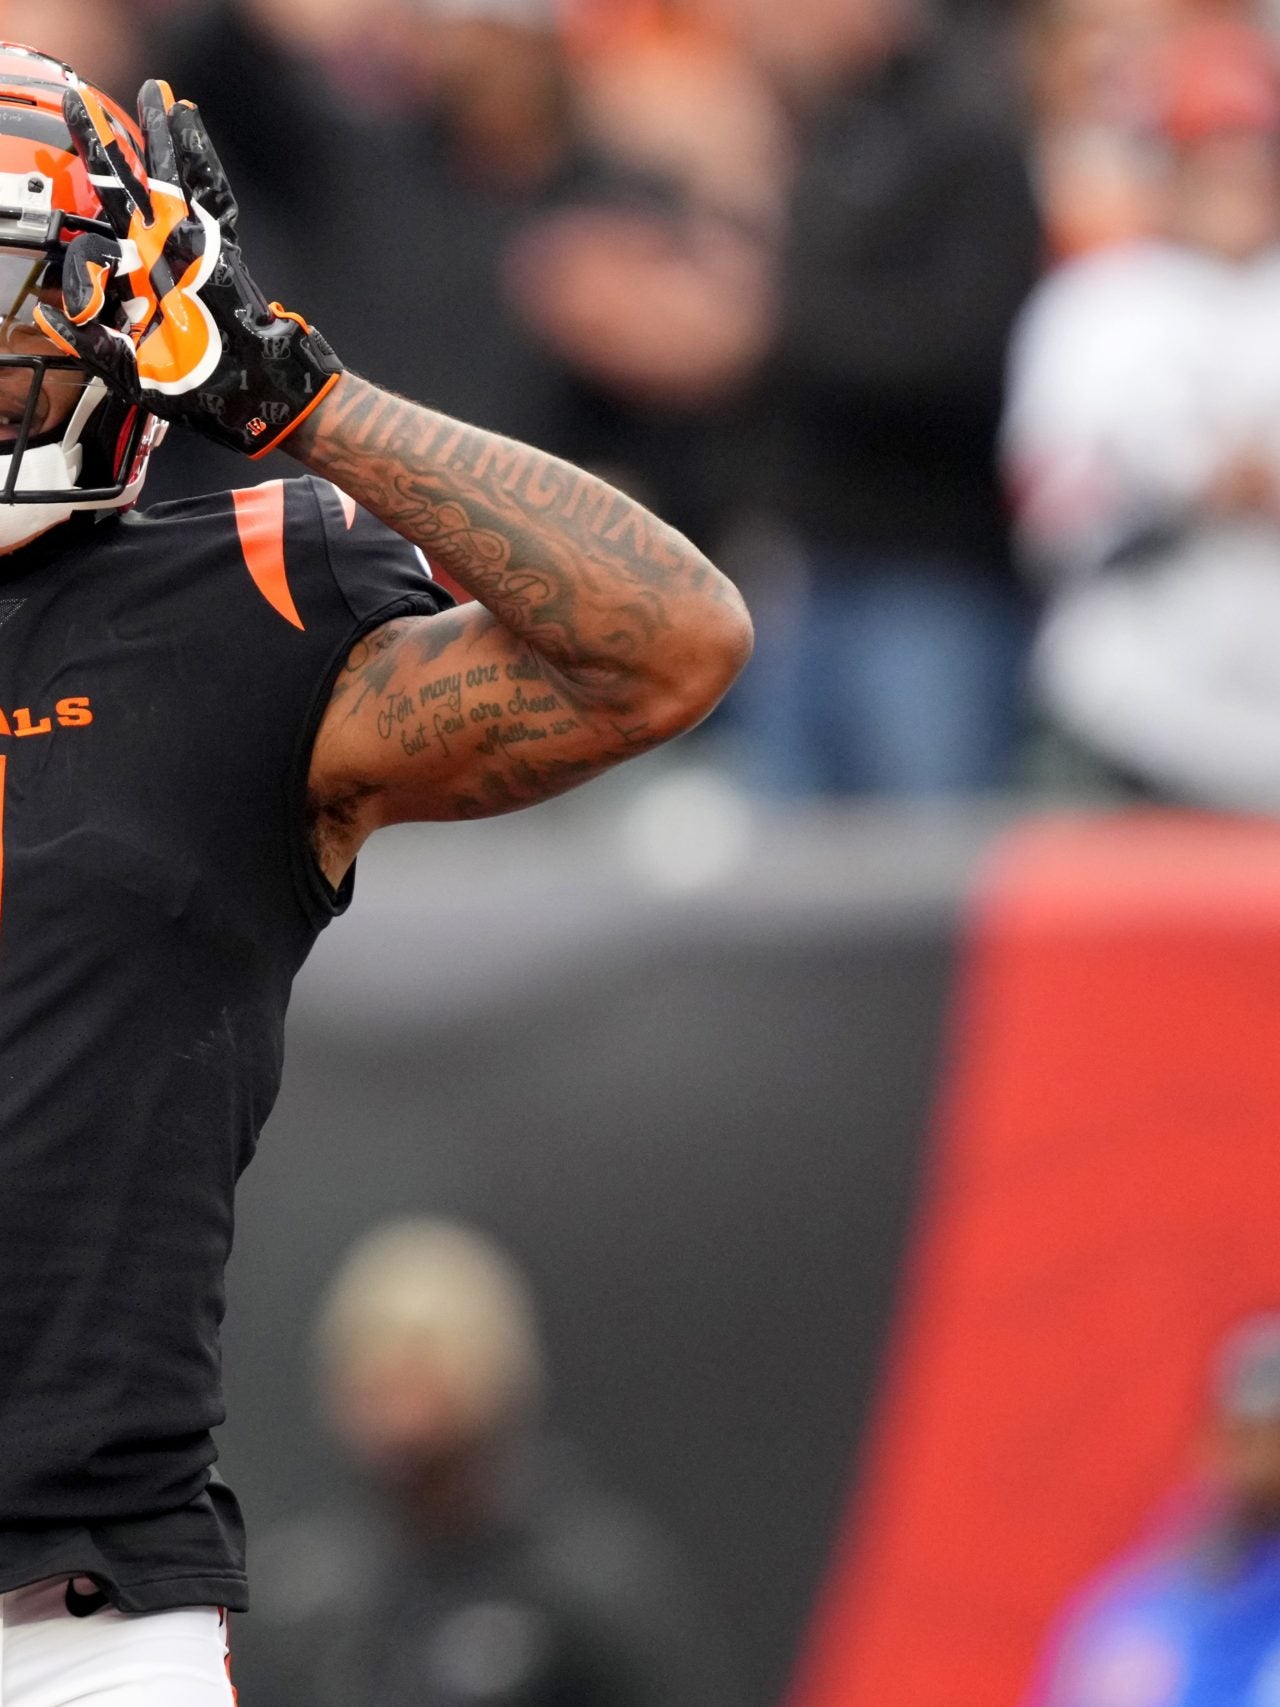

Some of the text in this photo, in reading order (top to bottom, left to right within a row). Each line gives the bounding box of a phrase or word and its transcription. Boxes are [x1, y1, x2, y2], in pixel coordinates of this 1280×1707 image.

[419, 672, 462, 713] many
[466, 664, 499, 688] are
[401, 721, 431, 756] but
[433, 713, 466, 758] few
[470, 702, 503, 723] are
